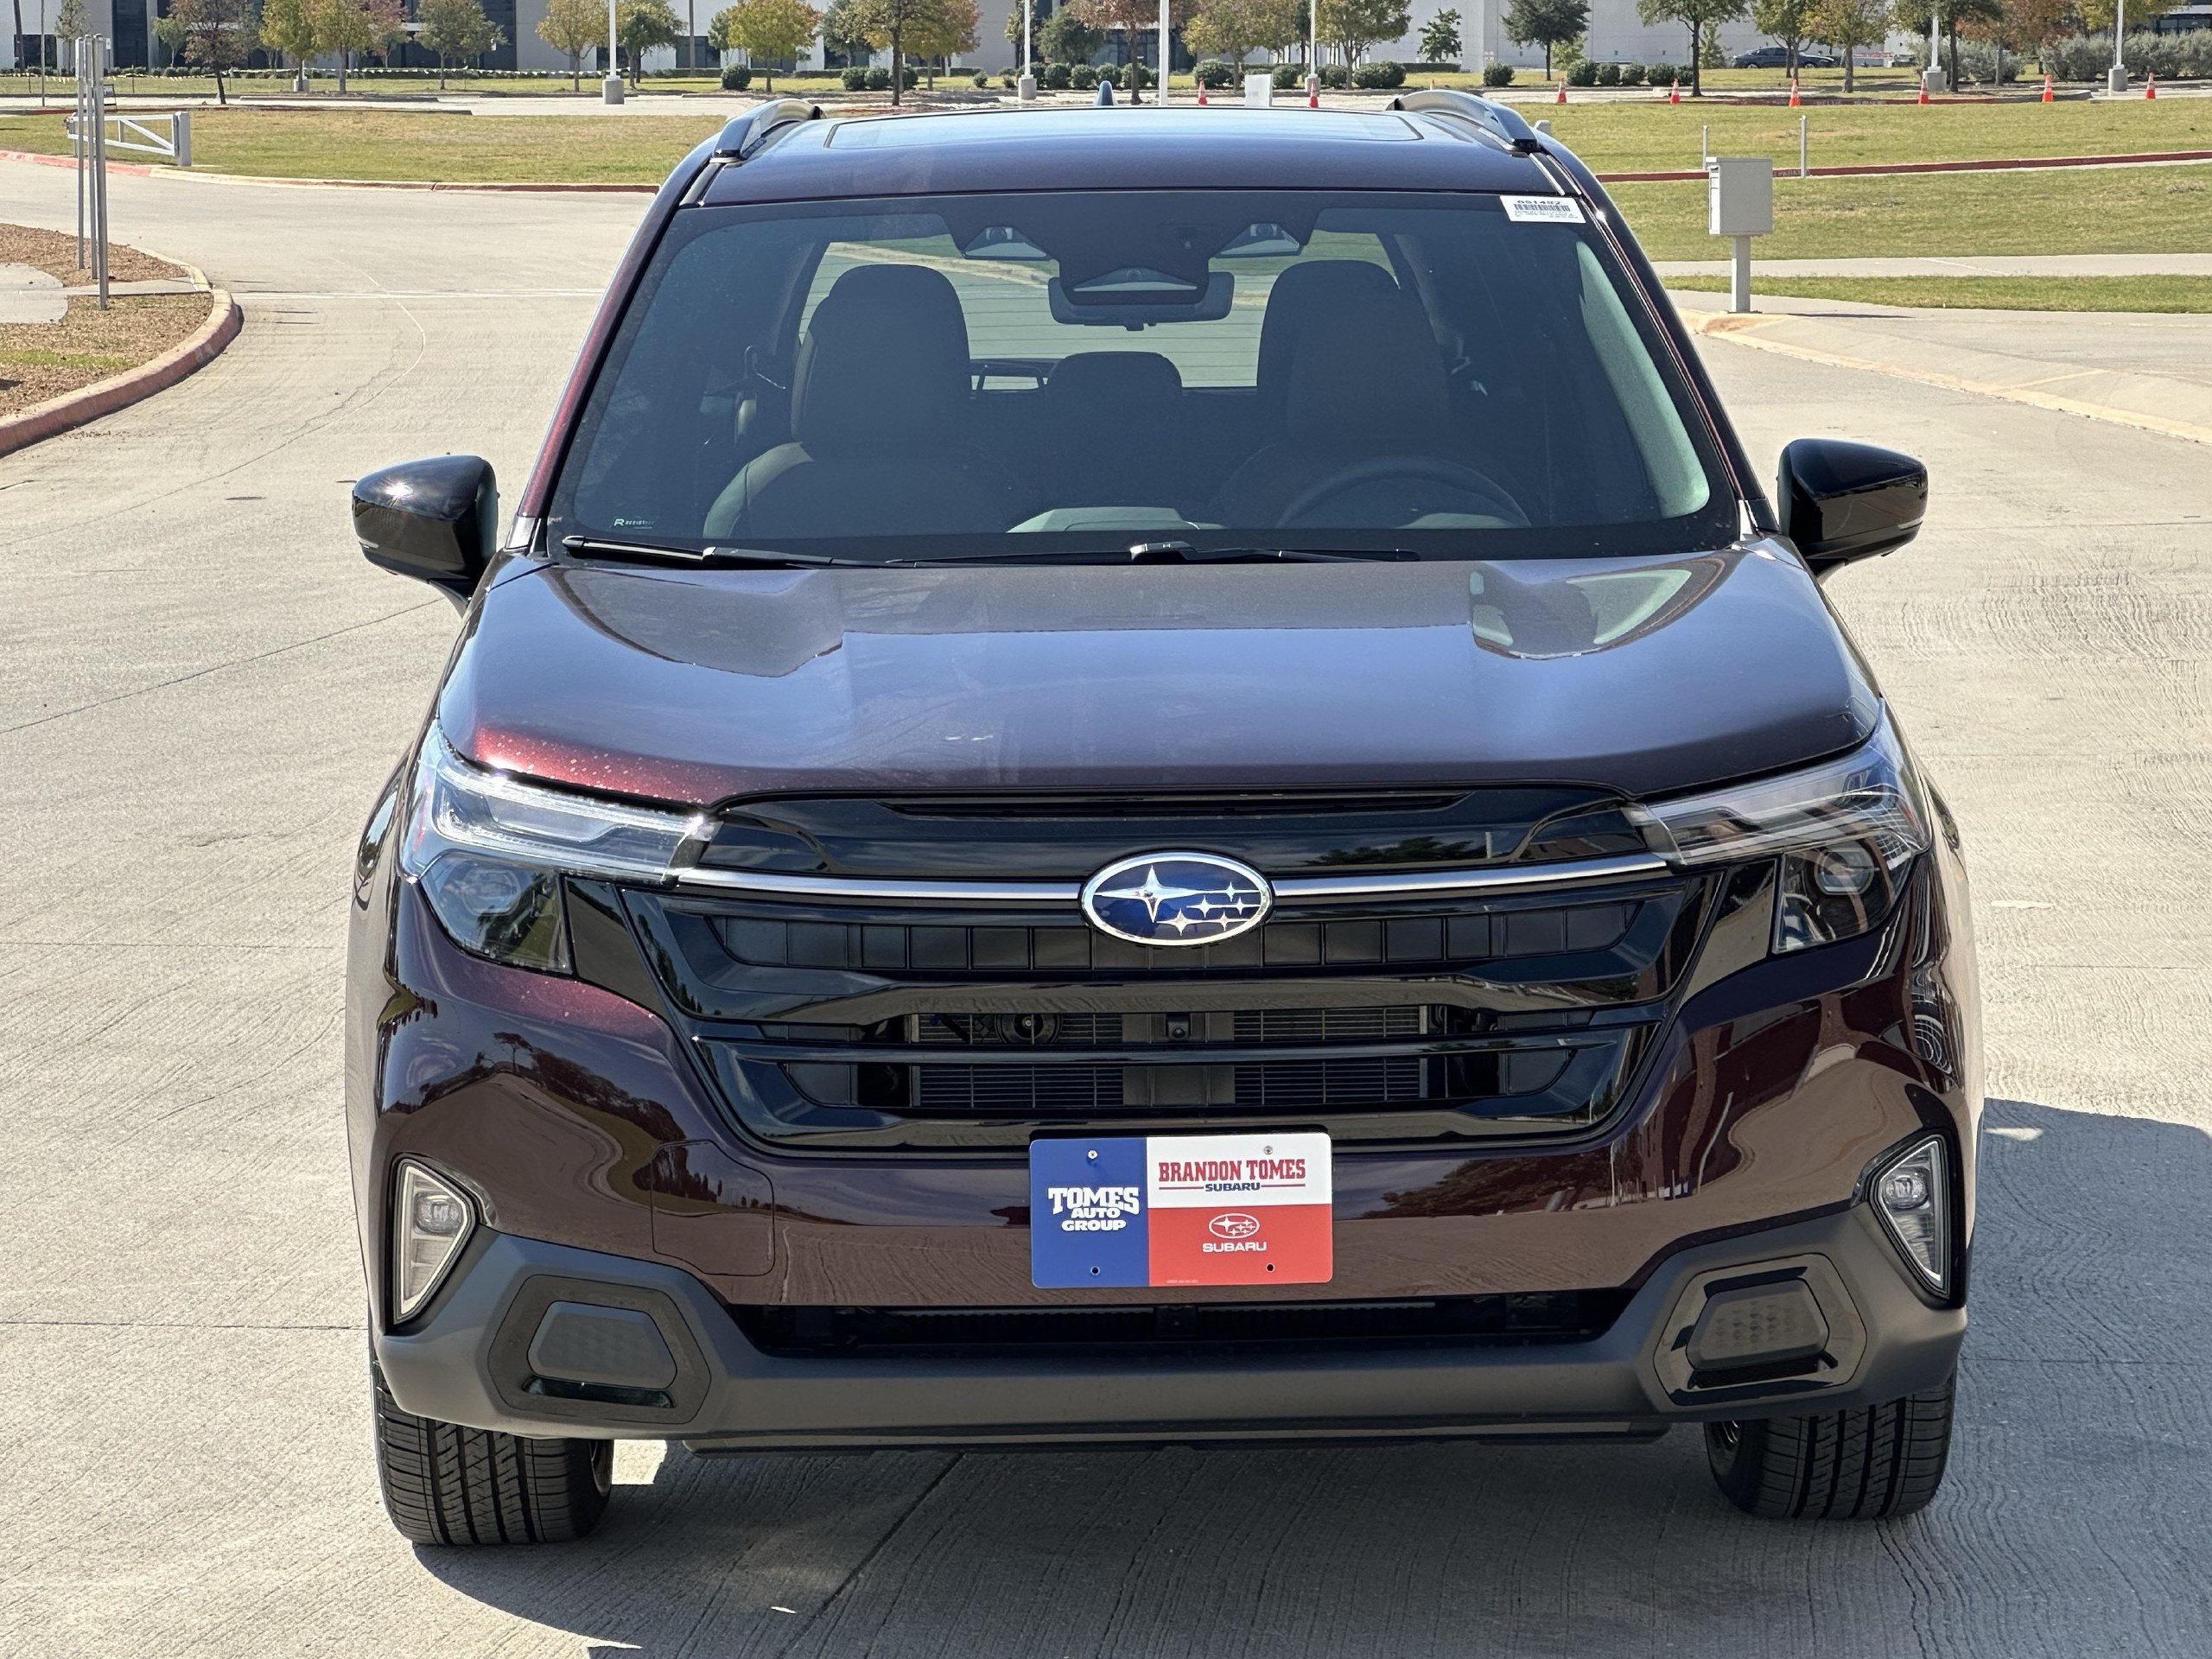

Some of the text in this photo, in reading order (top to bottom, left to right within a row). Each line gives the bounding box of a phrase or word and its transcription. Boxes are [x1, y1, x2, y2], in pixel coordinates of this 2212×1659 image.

[1158, 1159, 1306, 1182] BRANDON TOMES
[1205, 1182, 1261, 1192] SUBARU
[1048, 1187, 1140, 1215] TOMES
[1071, 1207, 1121, 1219] AUTO
[1061, 1219, 1127, 1231] GROUP
[1202, 1242, 1267, 1252] SUBARU
